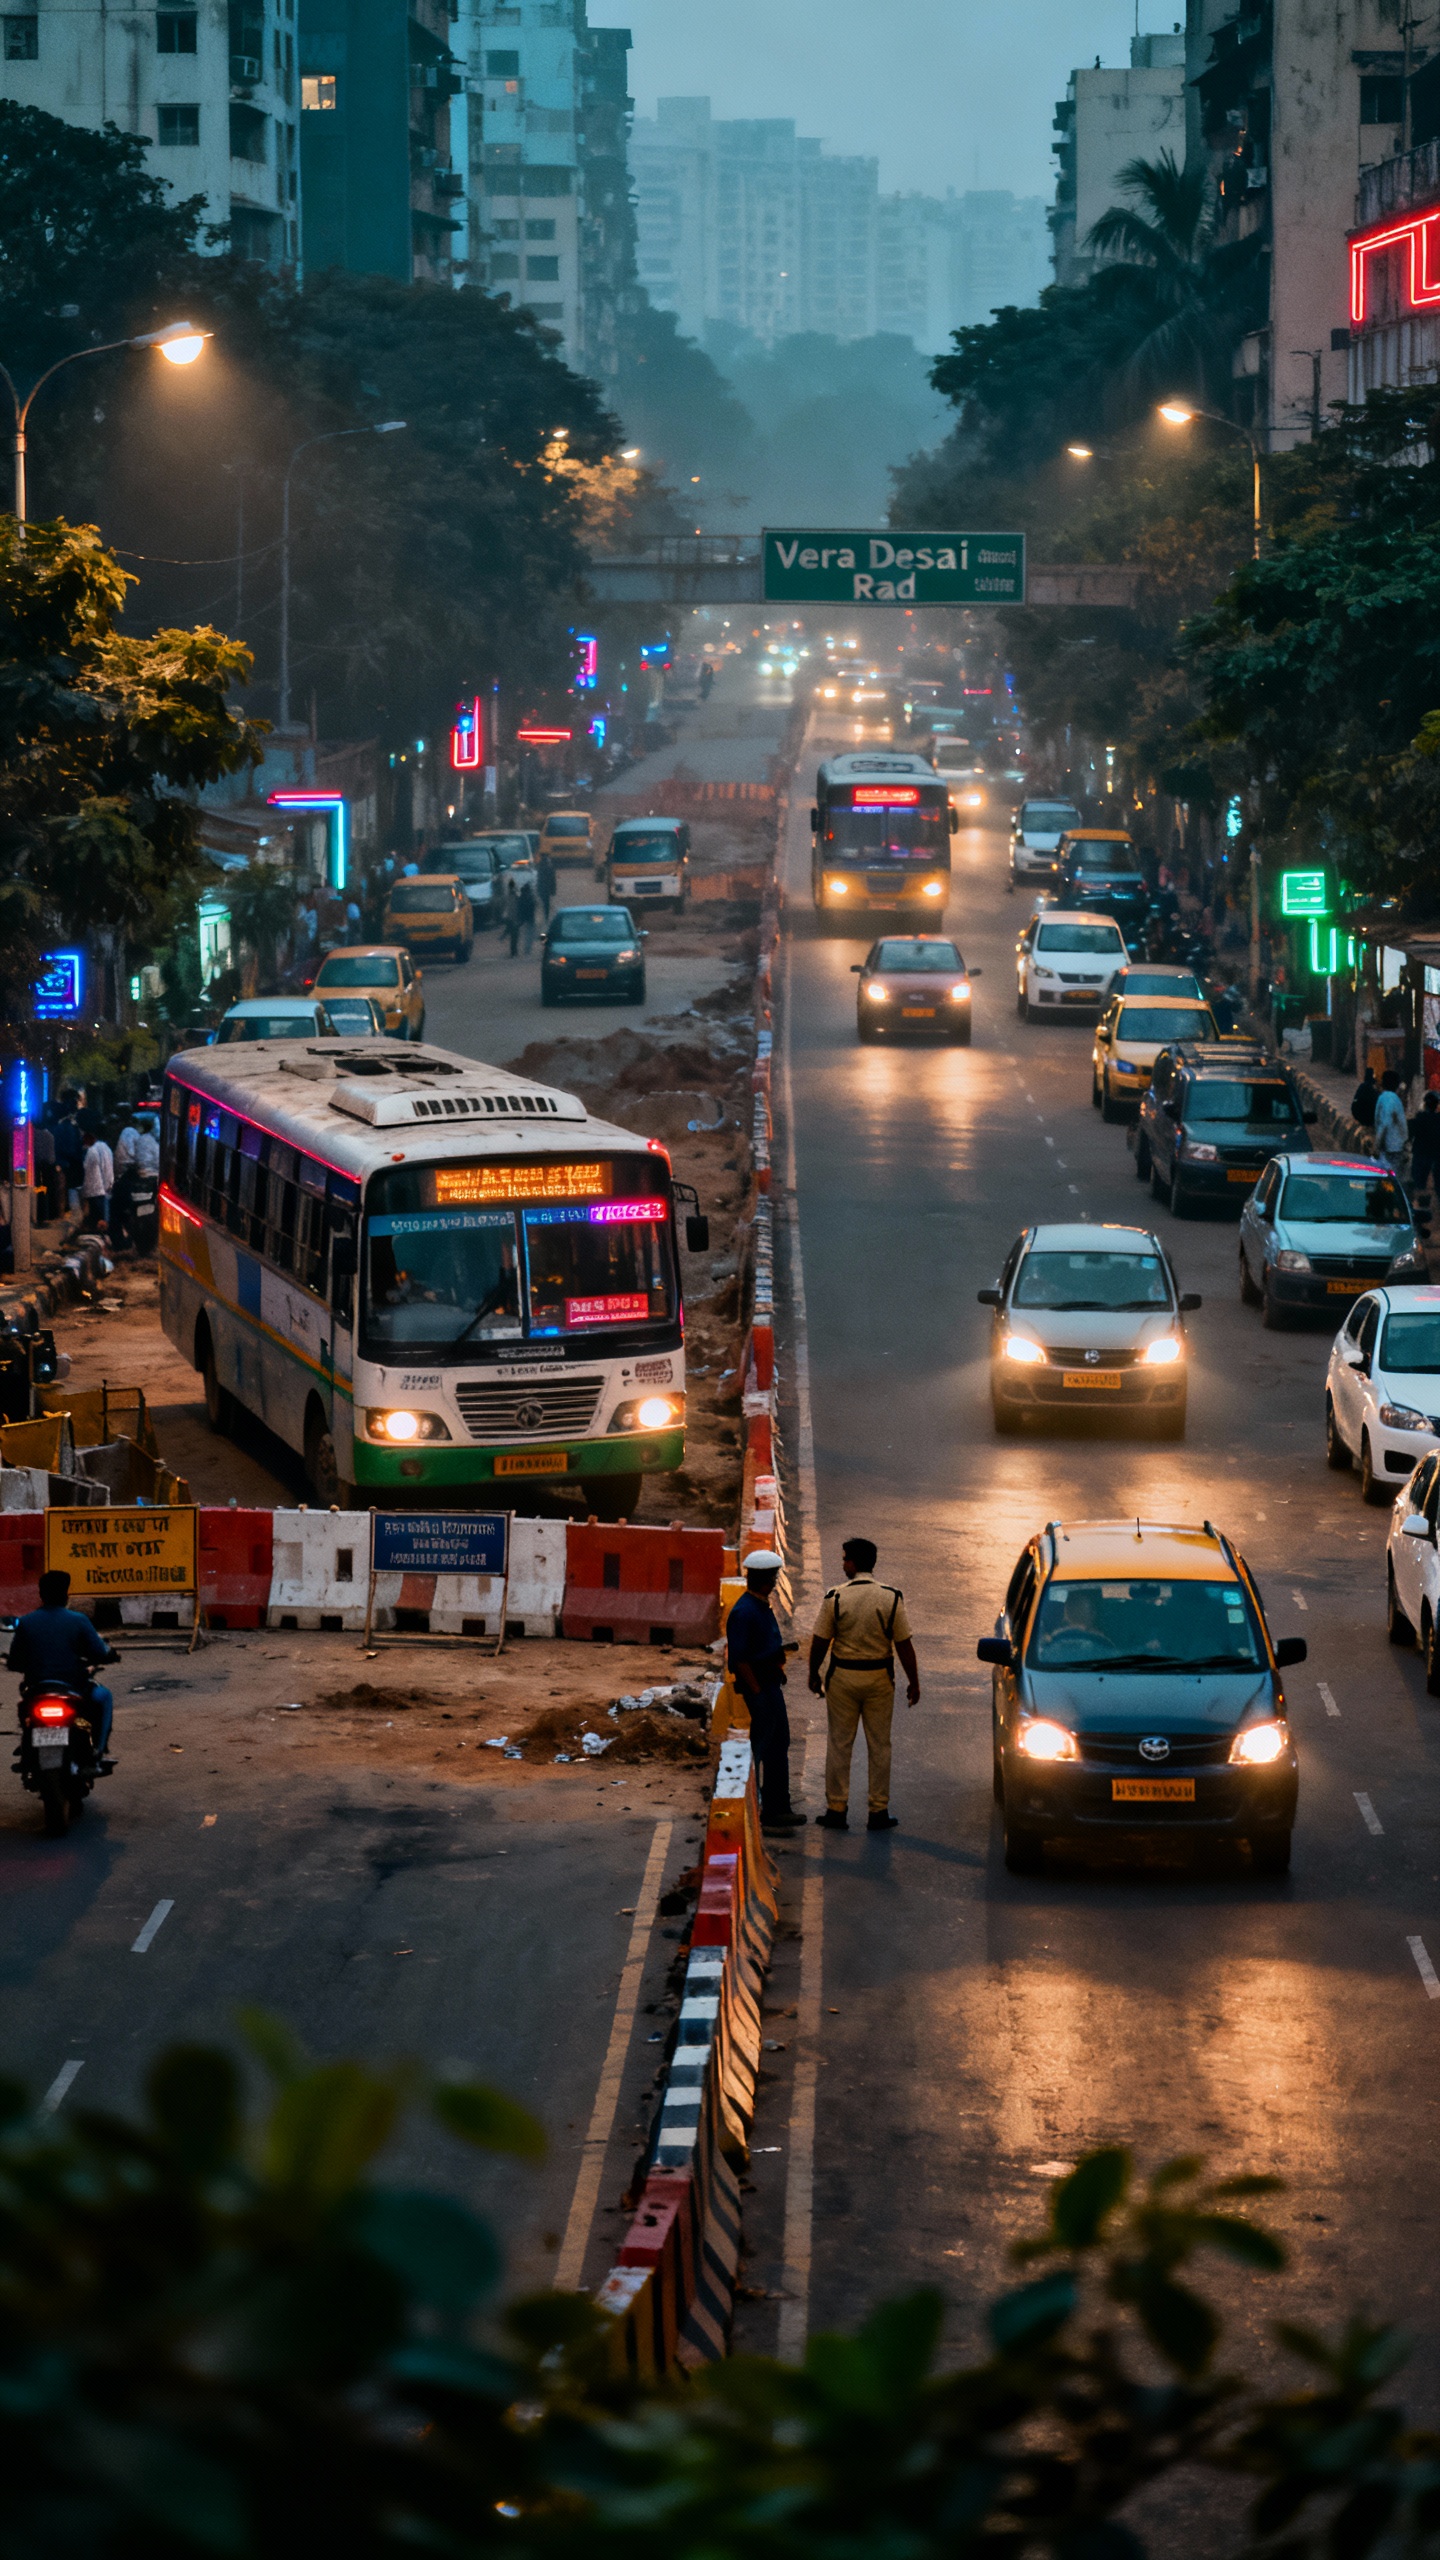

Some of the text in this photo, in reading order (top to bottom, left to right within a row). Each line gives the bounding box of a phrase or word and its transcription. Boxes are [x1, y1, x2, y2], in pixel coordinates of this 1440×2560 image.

[775, 540, 856, 570] Vera
[869, 539, 969, 571] Desai
[853, 572, 916, 600] Rad
